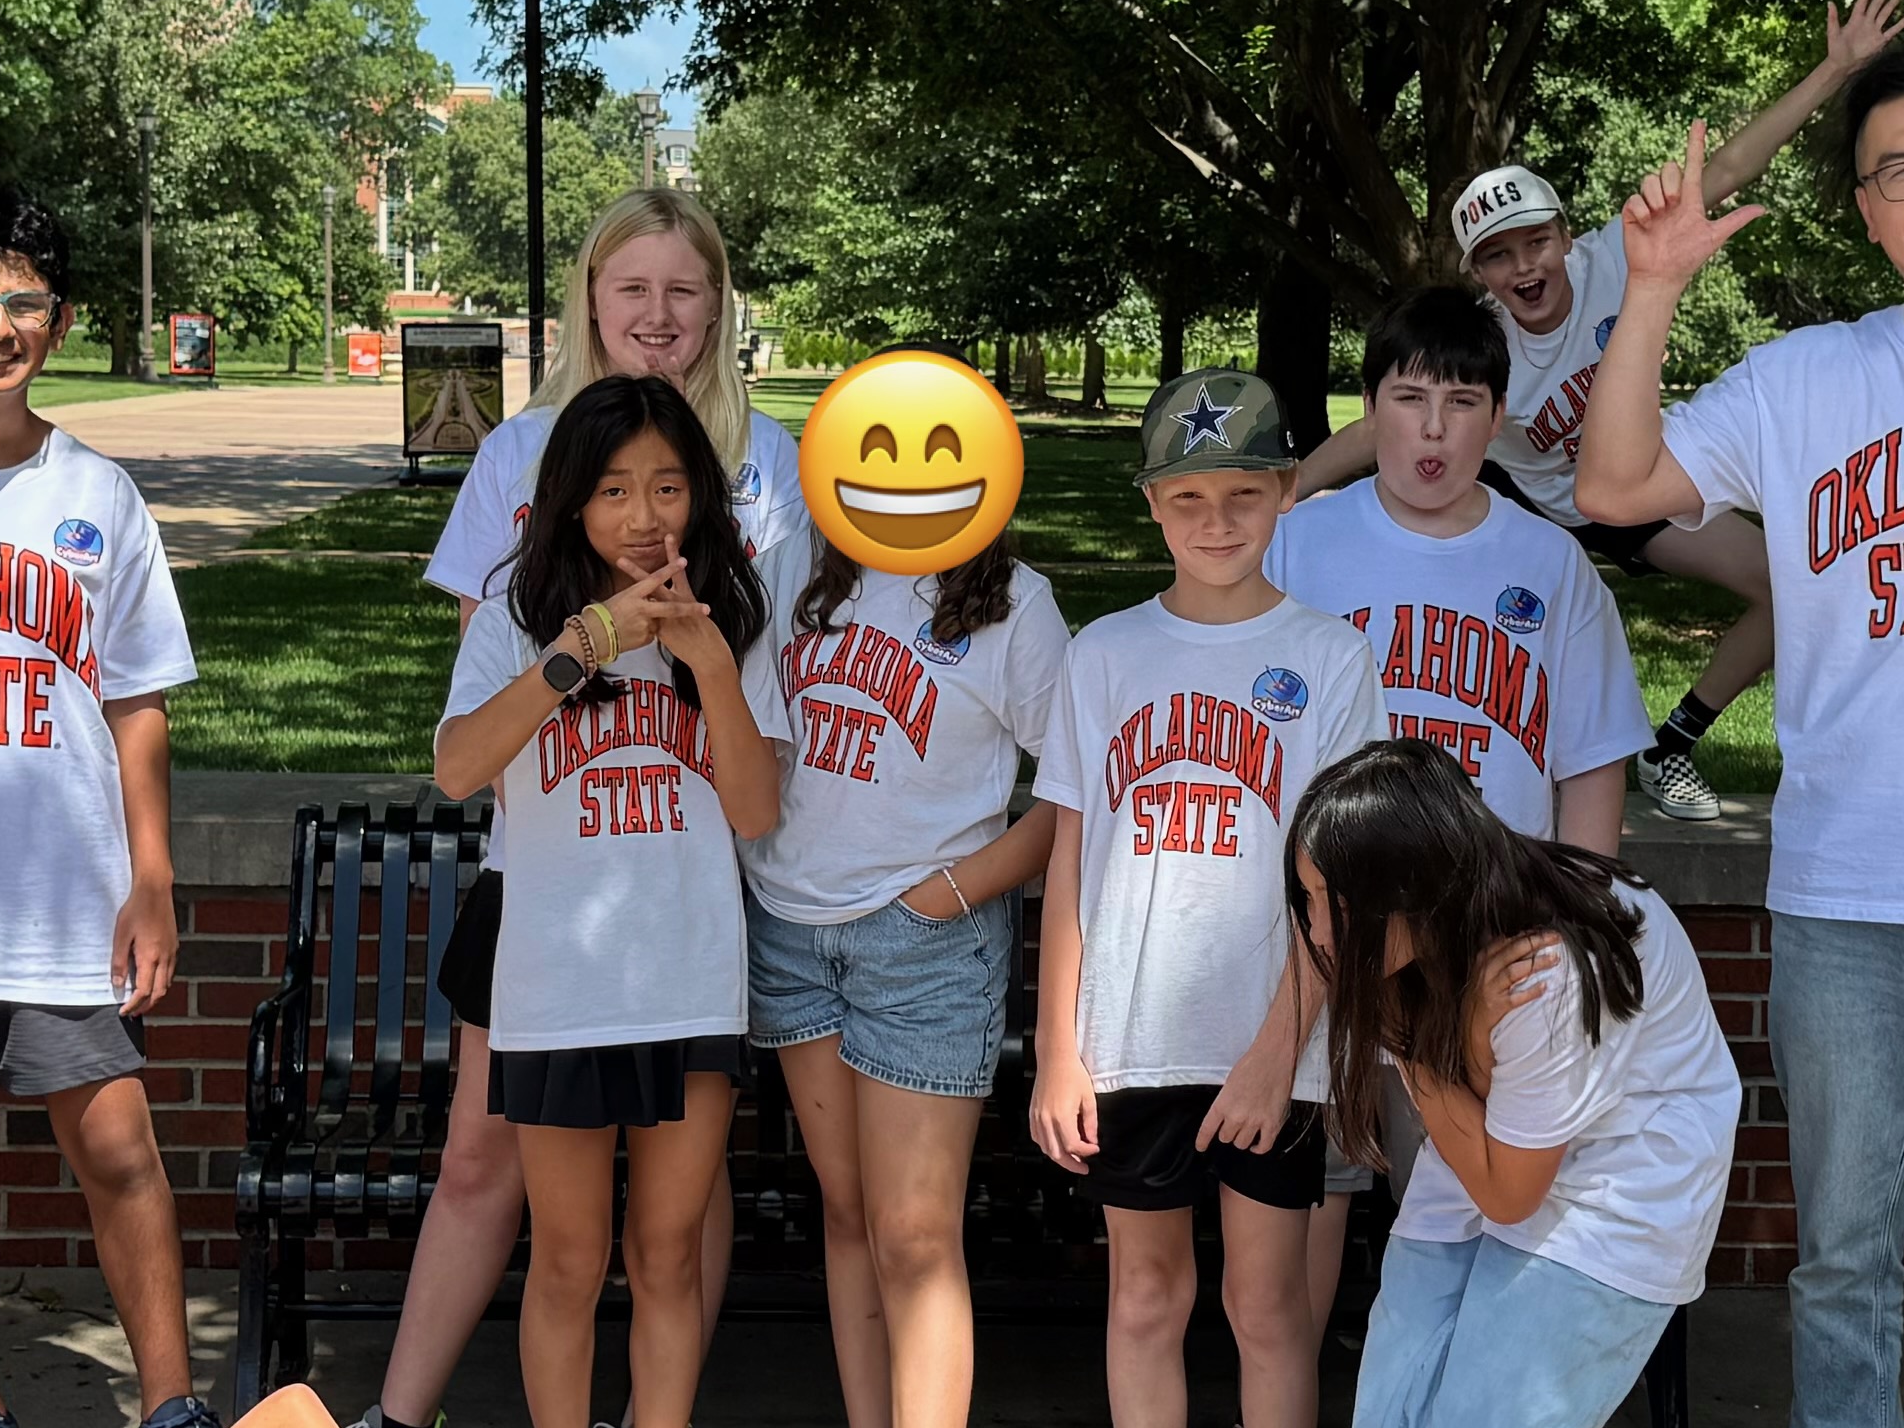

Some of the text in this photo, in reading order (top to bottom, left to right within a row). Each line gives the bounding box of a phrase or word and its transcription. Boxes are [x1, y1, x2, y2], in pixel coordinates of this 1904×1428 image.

[1460, 181, 1522, 235] POKES
[1252, 698, 1301, 719] CyberArt
[1106, 691, 1283, 827] OKLAHOMA
[580, 764, 684, 837] STATE
[1132, 781, 1242, 856] STATE
